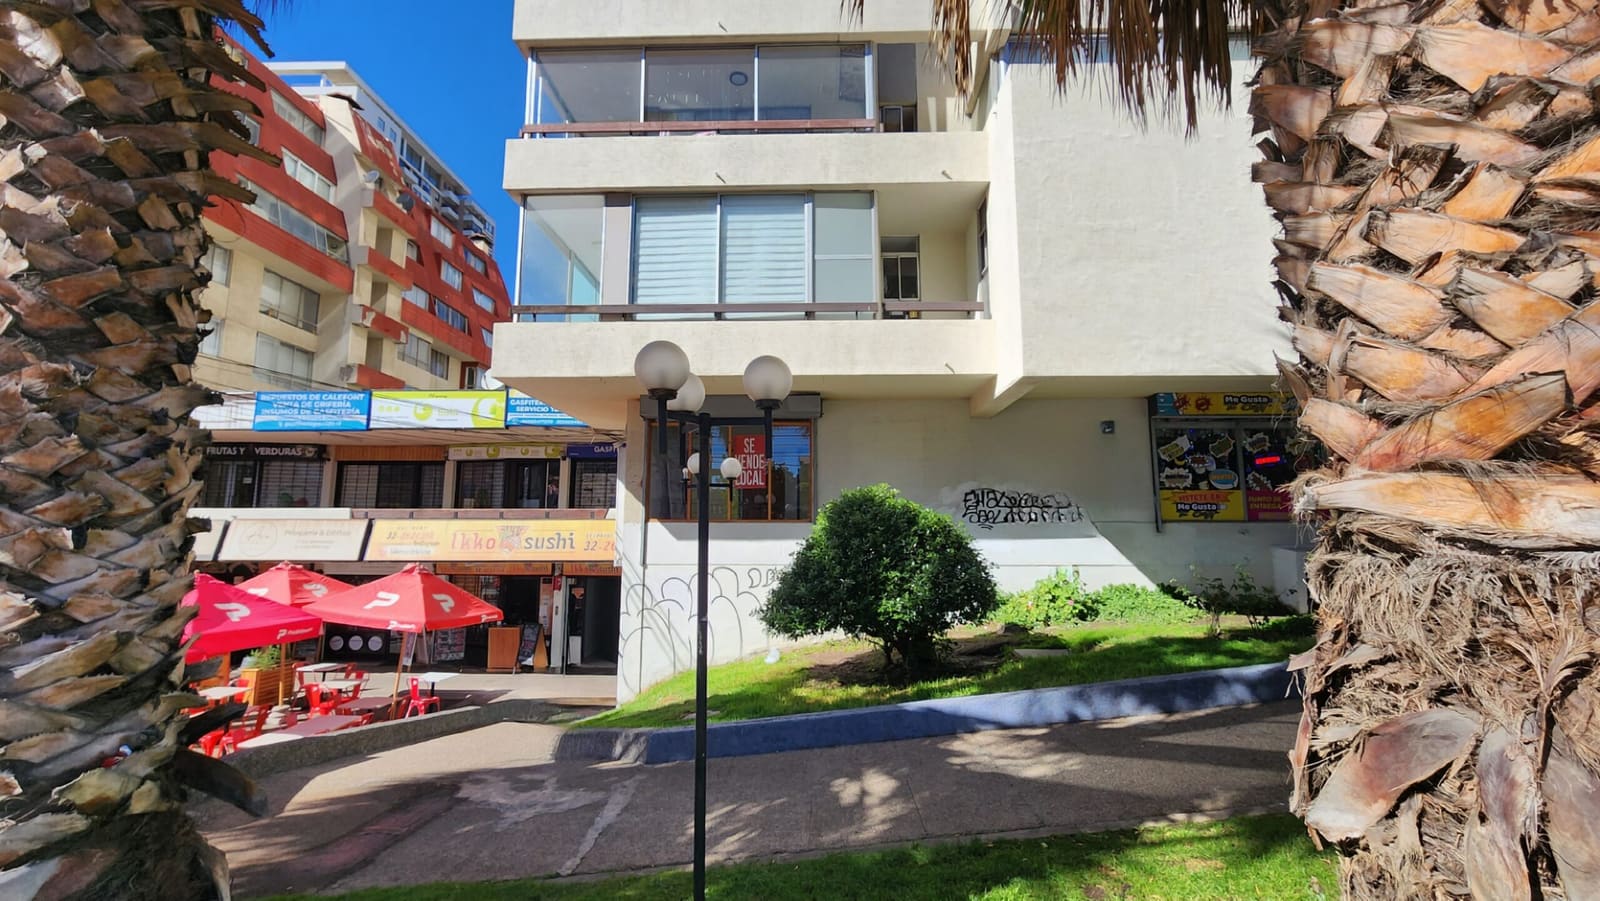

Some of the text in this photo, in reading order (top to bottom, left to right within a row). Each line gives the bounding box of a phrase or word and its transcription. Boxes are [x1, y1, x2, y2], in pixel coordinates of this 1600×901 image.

[206, 446, 302, 456] FRUTAS Y VERDURAS
[743, 438, 755, 453] SE
[735, 470, 766, 486] LOCAL
[524, 532, 576, 550] sushi
